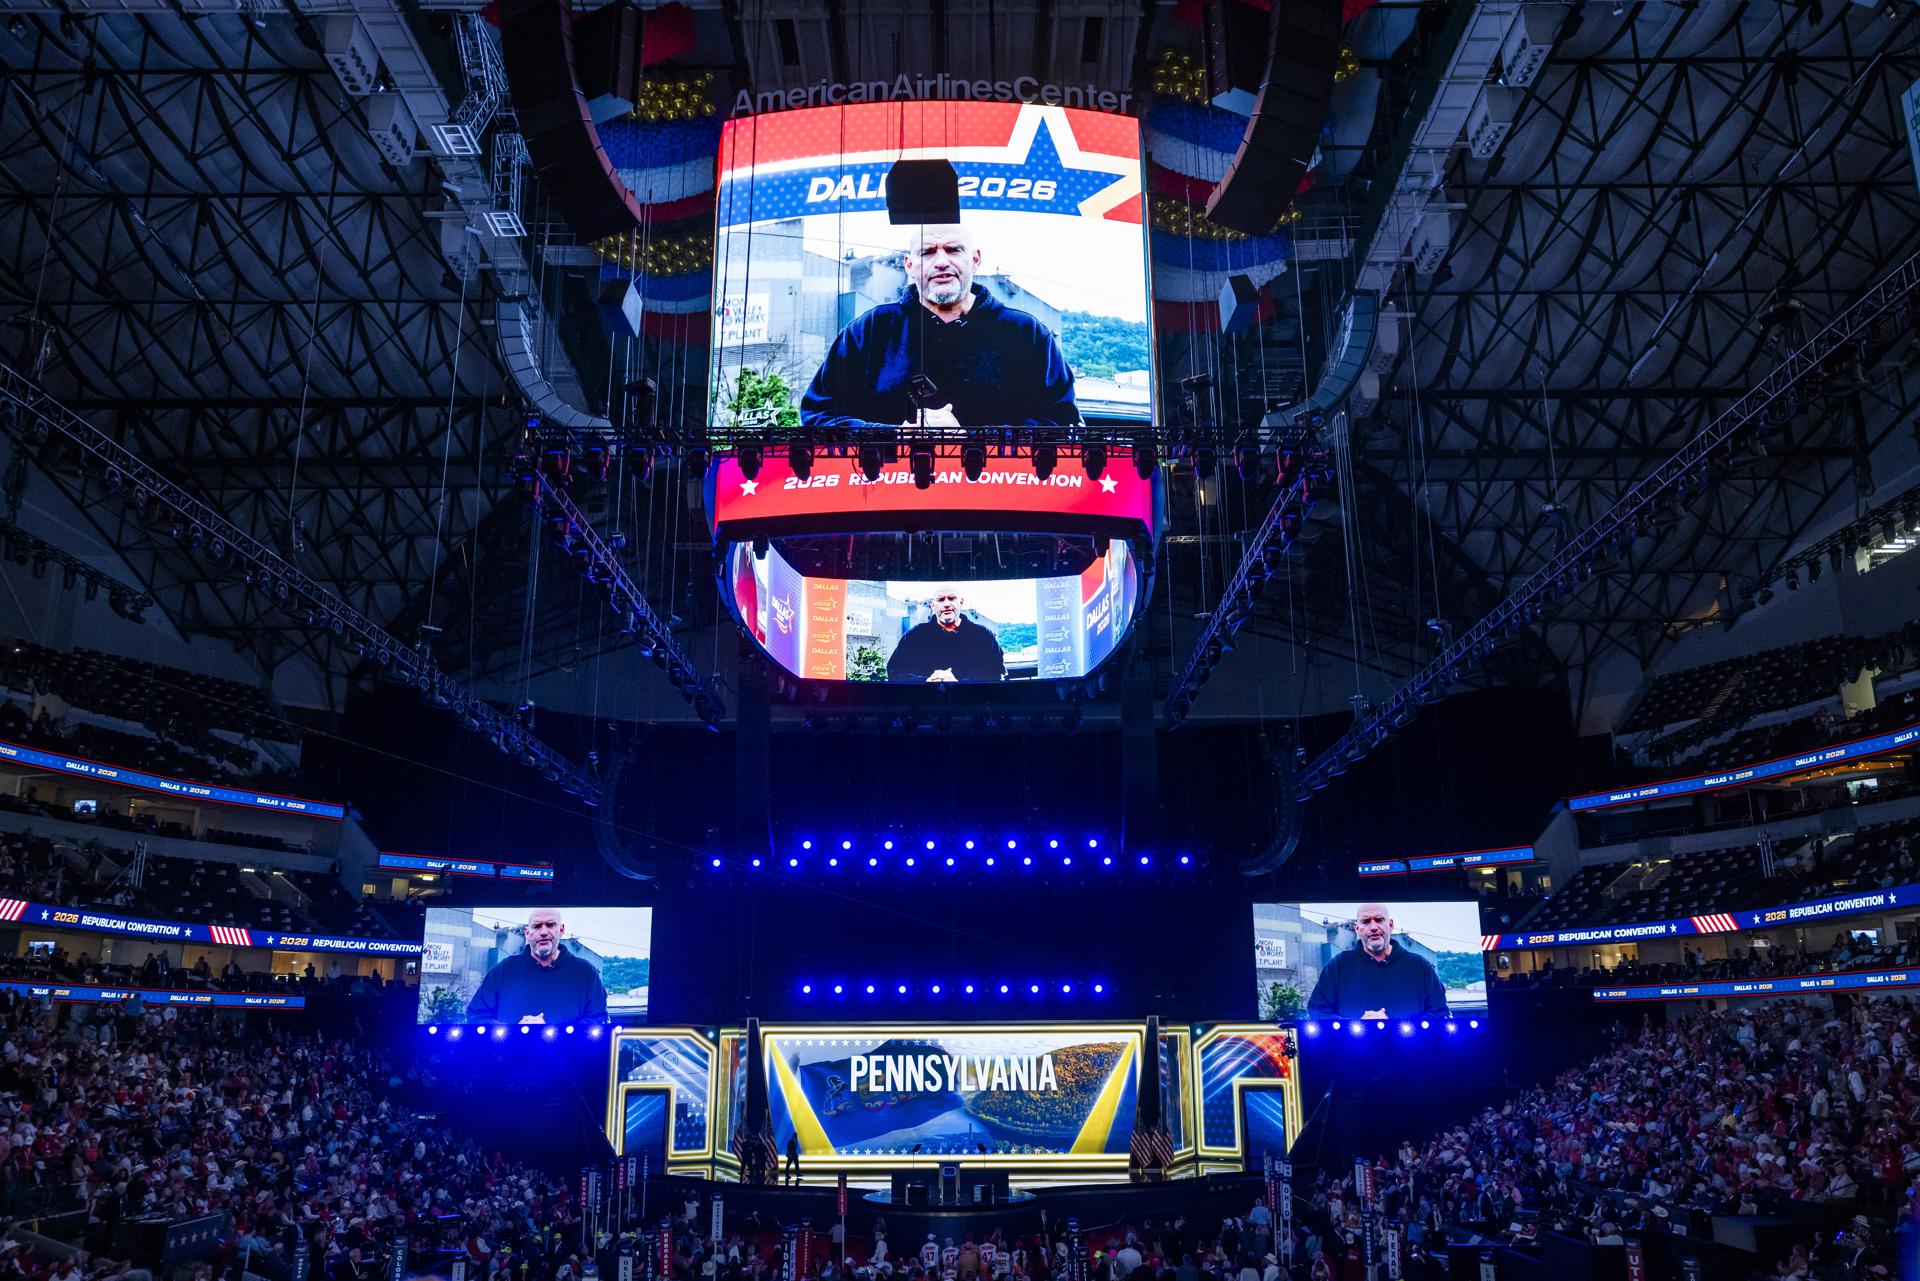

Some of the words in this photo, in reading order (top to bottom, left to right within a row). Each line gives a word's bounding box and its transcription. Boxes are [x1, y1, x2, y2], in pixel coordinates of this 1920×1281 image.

[959, 176, 1058, 200] 2026
[783, 474, 840, 489] 2026
[813, 583, 839, 591] DALLAS
[812, 615, 839, 623] DALLAS
[1087, 594, 1109, 630] DALLAS
[812, 647, 838, 655] DALLAS
[1045, 646, 1072, 654] DALLAS
[1894, 732, 1913, 743] DALLAS
[1795, 755, 1817, 766] DALLAS
[1825, 750, 1845, 759] 2026
[66, 762, 89, 772] DALLAS
[97, 768, 117, 778] 2026
[1704, 776, 1727, 785] DALLAS
[1735, 771, 1753, 780] 2026
[160, 781, 180, 791] DALLAS
[189, 787, 210, 795] 2026
[257, 797, 279, 806] DALLAS
[287, 802, 306, 810] 2026
[1610, 792, 1631, 801] DALLAS
[1765, 910, 1787, 922] 2026
[1789, 903, 1833, 918] REPUBLICAN
[1834, 894, 1884, 911] CONVENTION
[53, 911, 79, 924] 2026
[81, 915, 126, 930] REPUBLICAN
[127, 921, 180, 936] CONVENTION
[1529, 935, 1554, 944] 2026
[1559, 930, 1612, 942] REPUBLICAN
[1614, 925, 1666, 937] CONVENTION
[280, 937, 309, 946] 2026
[313, 939, 366, 950] REPUBLICAN
[368, 942, 423, 953] CONVENTION
[850, 1054, 1058, 1092] PENNSYLVANIA
[925, 1252, 935, 1261] 47
[982, 1252, 993, 1262] 47
[296, 1257, 304, 1279] NORTH
